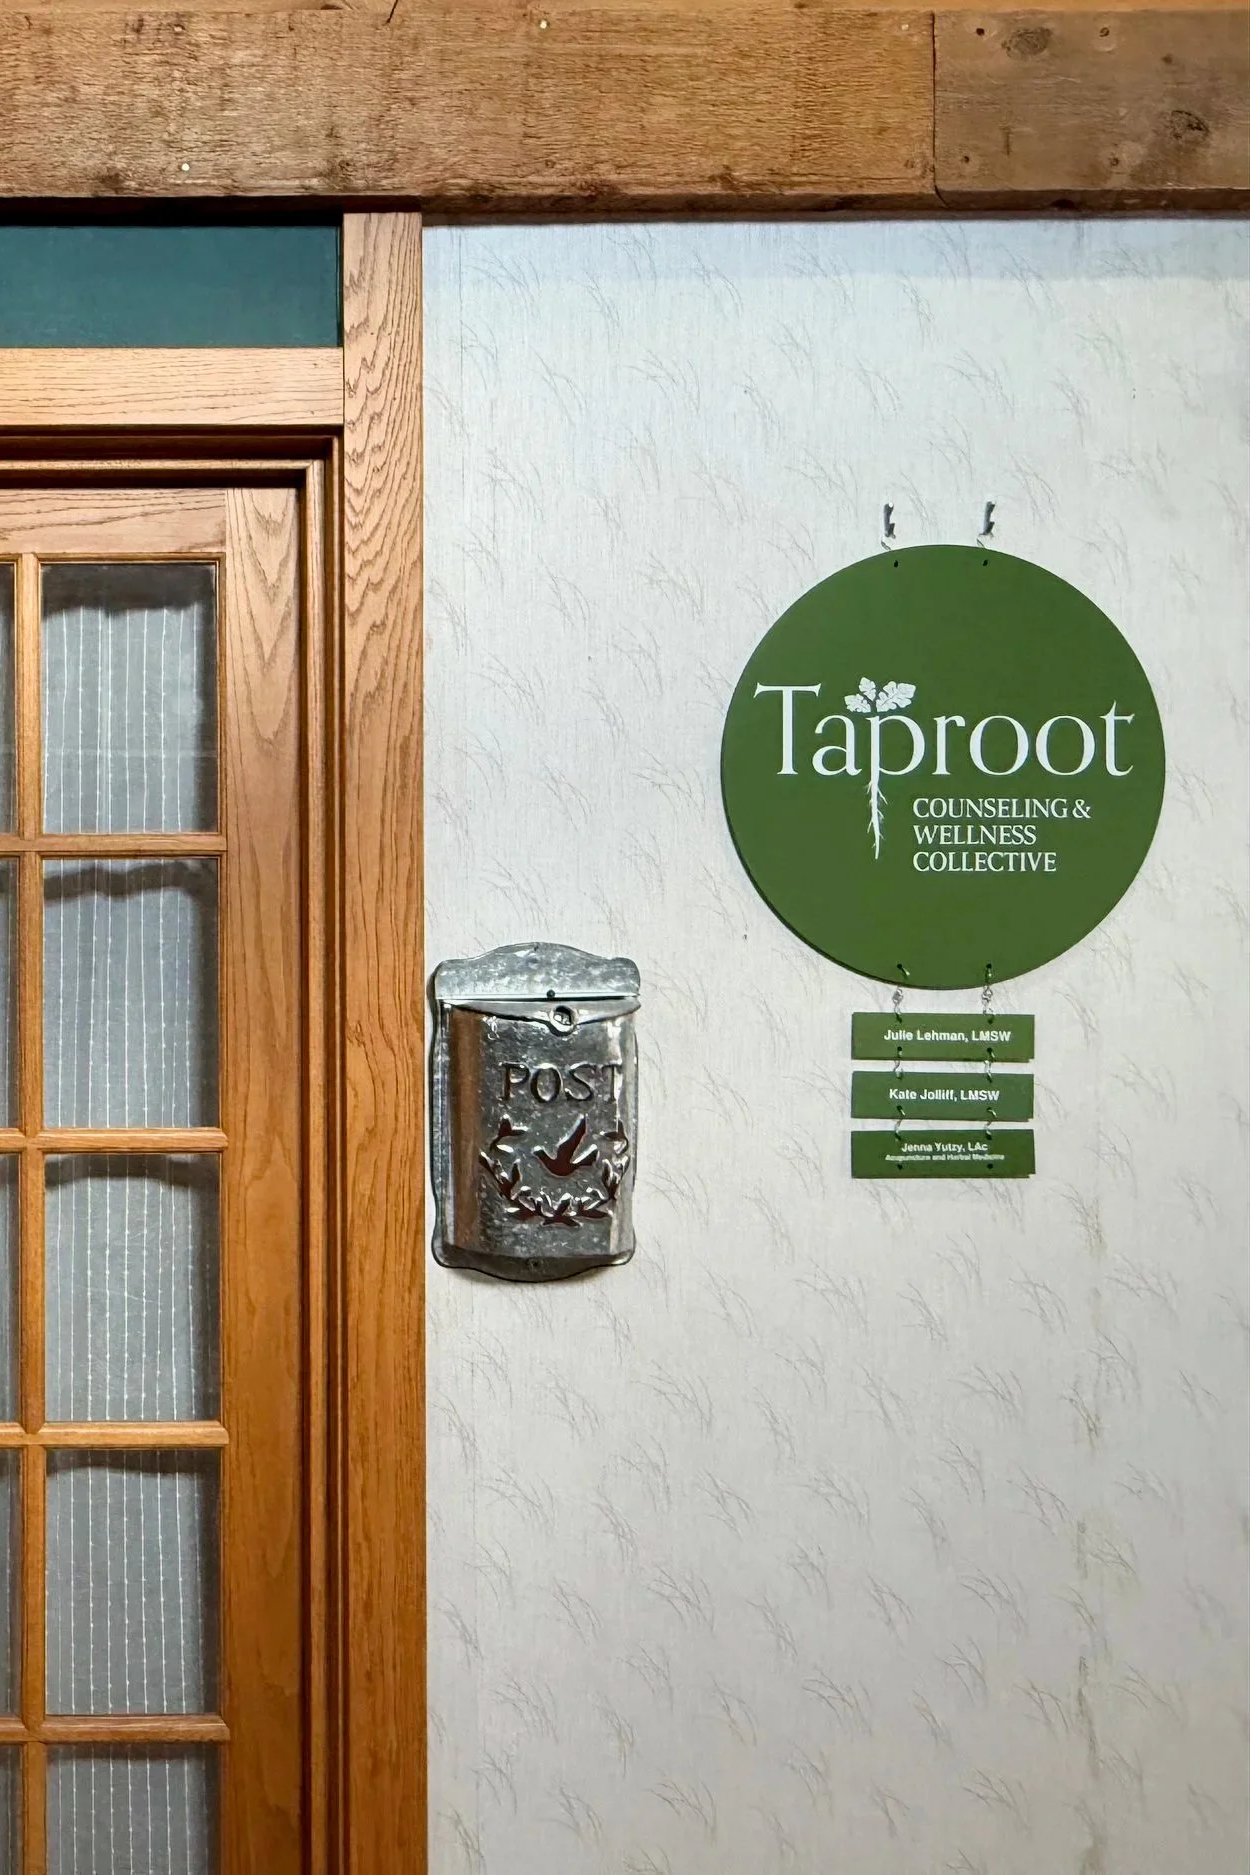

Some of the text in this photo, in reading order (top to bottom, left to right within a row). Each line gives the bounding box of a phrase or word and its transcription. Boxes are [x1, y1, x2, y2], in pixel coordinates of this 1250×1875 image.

[753, 682, 1135, 859] Taproot
[912, 797, 1092, 819] COUNSELING &
[913, 824, 1038, 845] WELLNESS
[912, 851, 1058, 872] COLLECTIVE
[883, 1029, 1012, 1043] Julie Lehman, LMSW
[499, 1061, 622, 1102] POST
[889, 1088, 1000, 1102] Kate Jolliff, LMSW
[901, 1142, 933, 1152] Jenna
[967, 1141, 989, 1152] LAc
